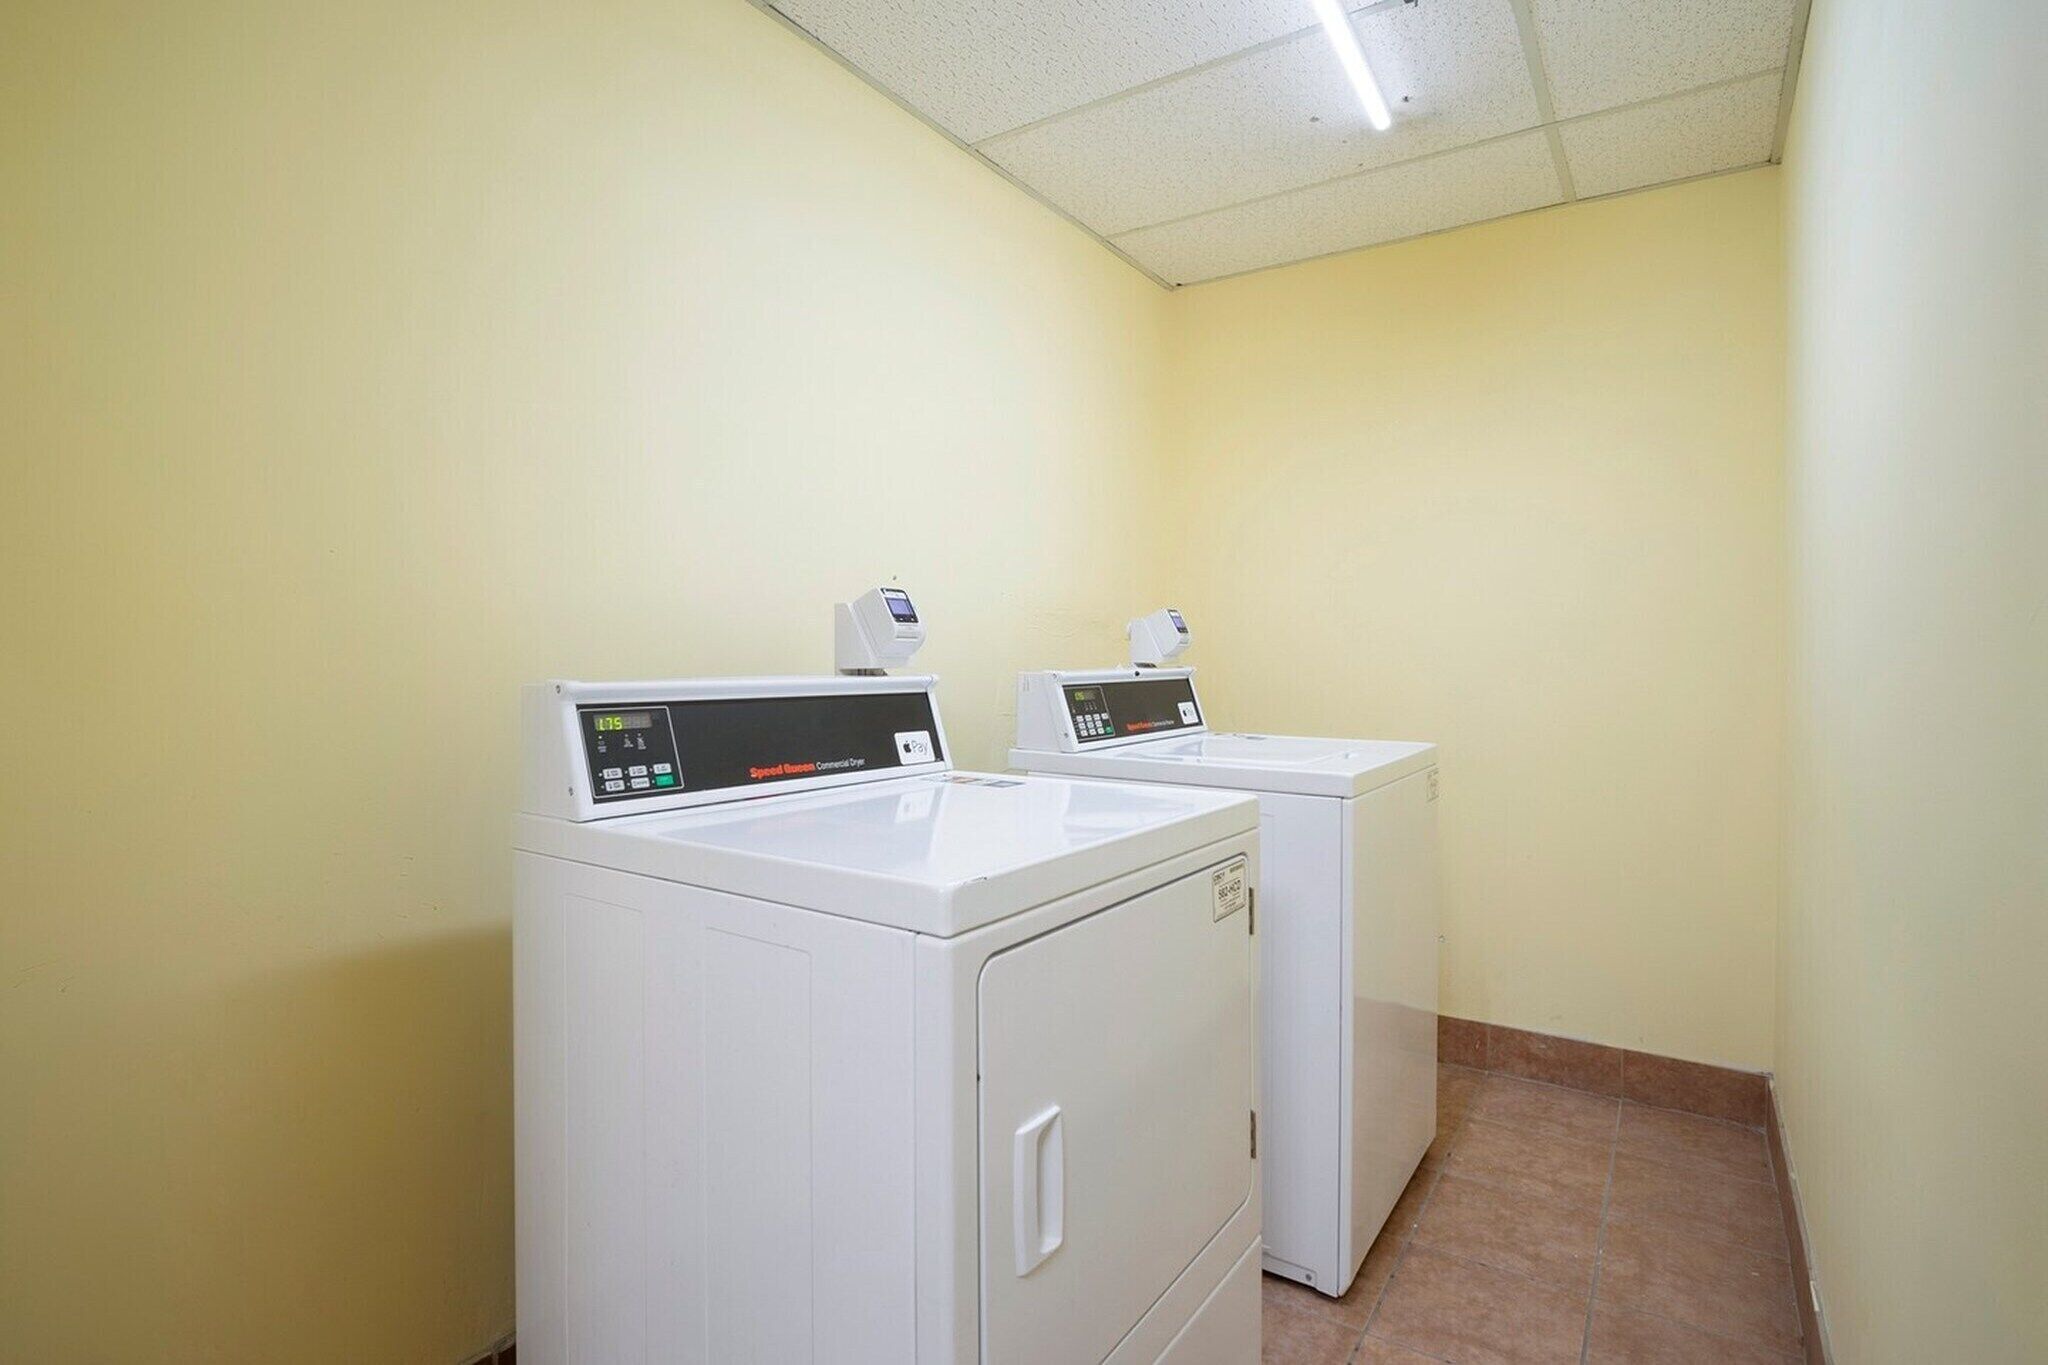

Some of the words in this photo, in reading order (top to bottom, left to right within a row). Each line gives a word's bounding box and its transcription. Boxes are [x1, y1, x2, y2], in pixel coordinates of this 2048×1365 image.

[911, 740, 928, 755] Pay
[749, 764, 783, 779] Speed
[784, 763, 815, 774] Queen
[816, 760, 849, 770] Commercial
